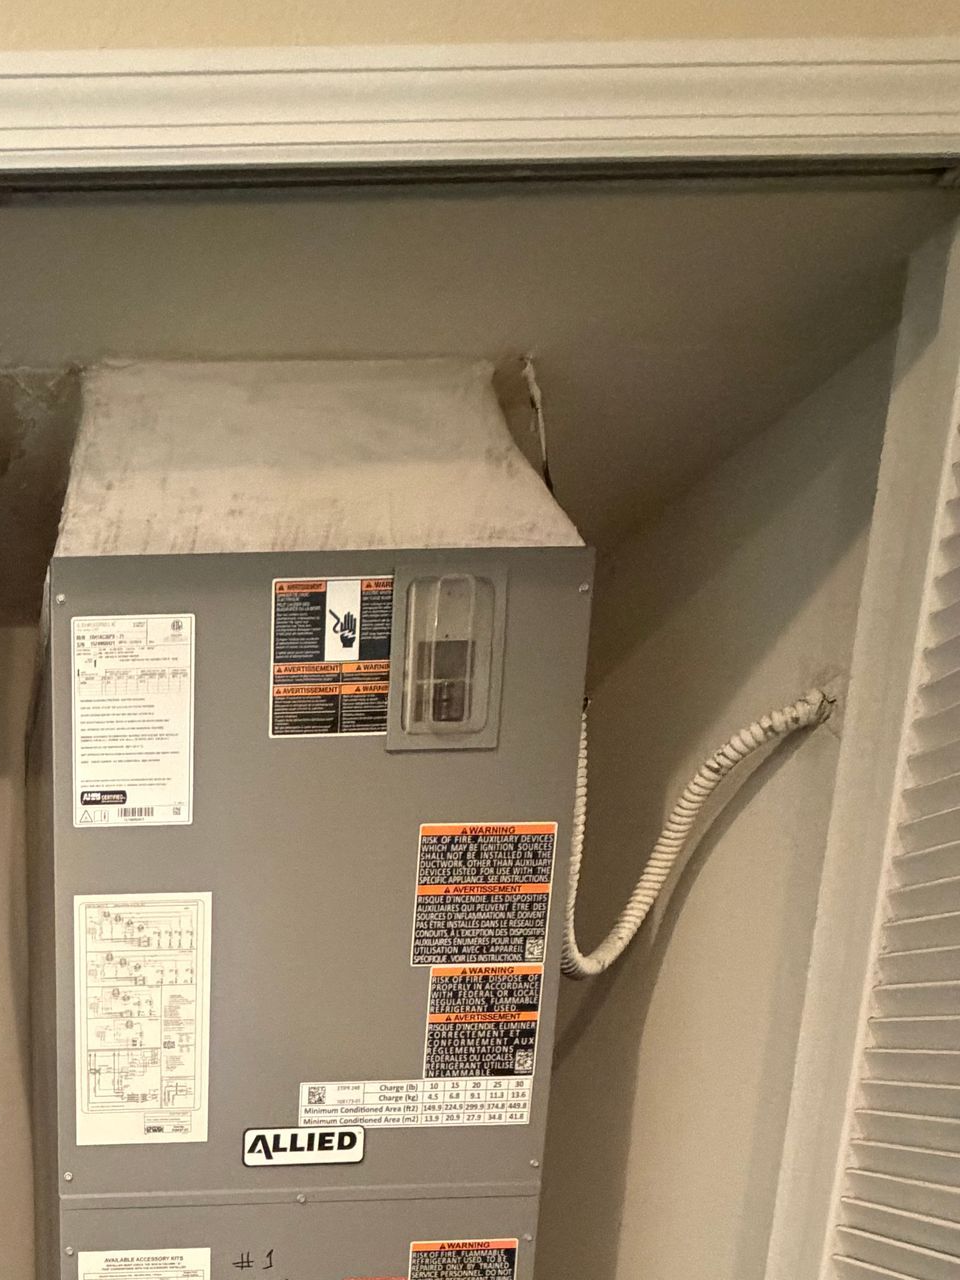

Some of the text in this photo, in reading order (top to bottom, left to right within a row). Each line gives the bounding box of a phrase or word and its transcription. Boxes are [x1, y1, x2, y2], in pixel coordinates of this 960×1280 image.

[469, 826, 516, 835] WARNING
[453, 885, 522, 893] AVERTISSEMENT
[469, 966, 514, 975] WARNING
[485, 982, 539, 990] ACCORDANCE
[513, 989, 539, 997] LOCAL
[490, 996, 538, 1004] FLAMMABLE
[493, 1004, 519, 1012] USED.
[454, 1013, 521, 1021] AVERTISSEMENT
[379, 1084, 404, 1092] Charge
[405, 1094, 418, 1102] (kg)
[340, 1106, 383, 1114] Conditioned
[403, 1105, 419, 1113] (ft2)
[247, 1131, 357, 1160] ALLIED
